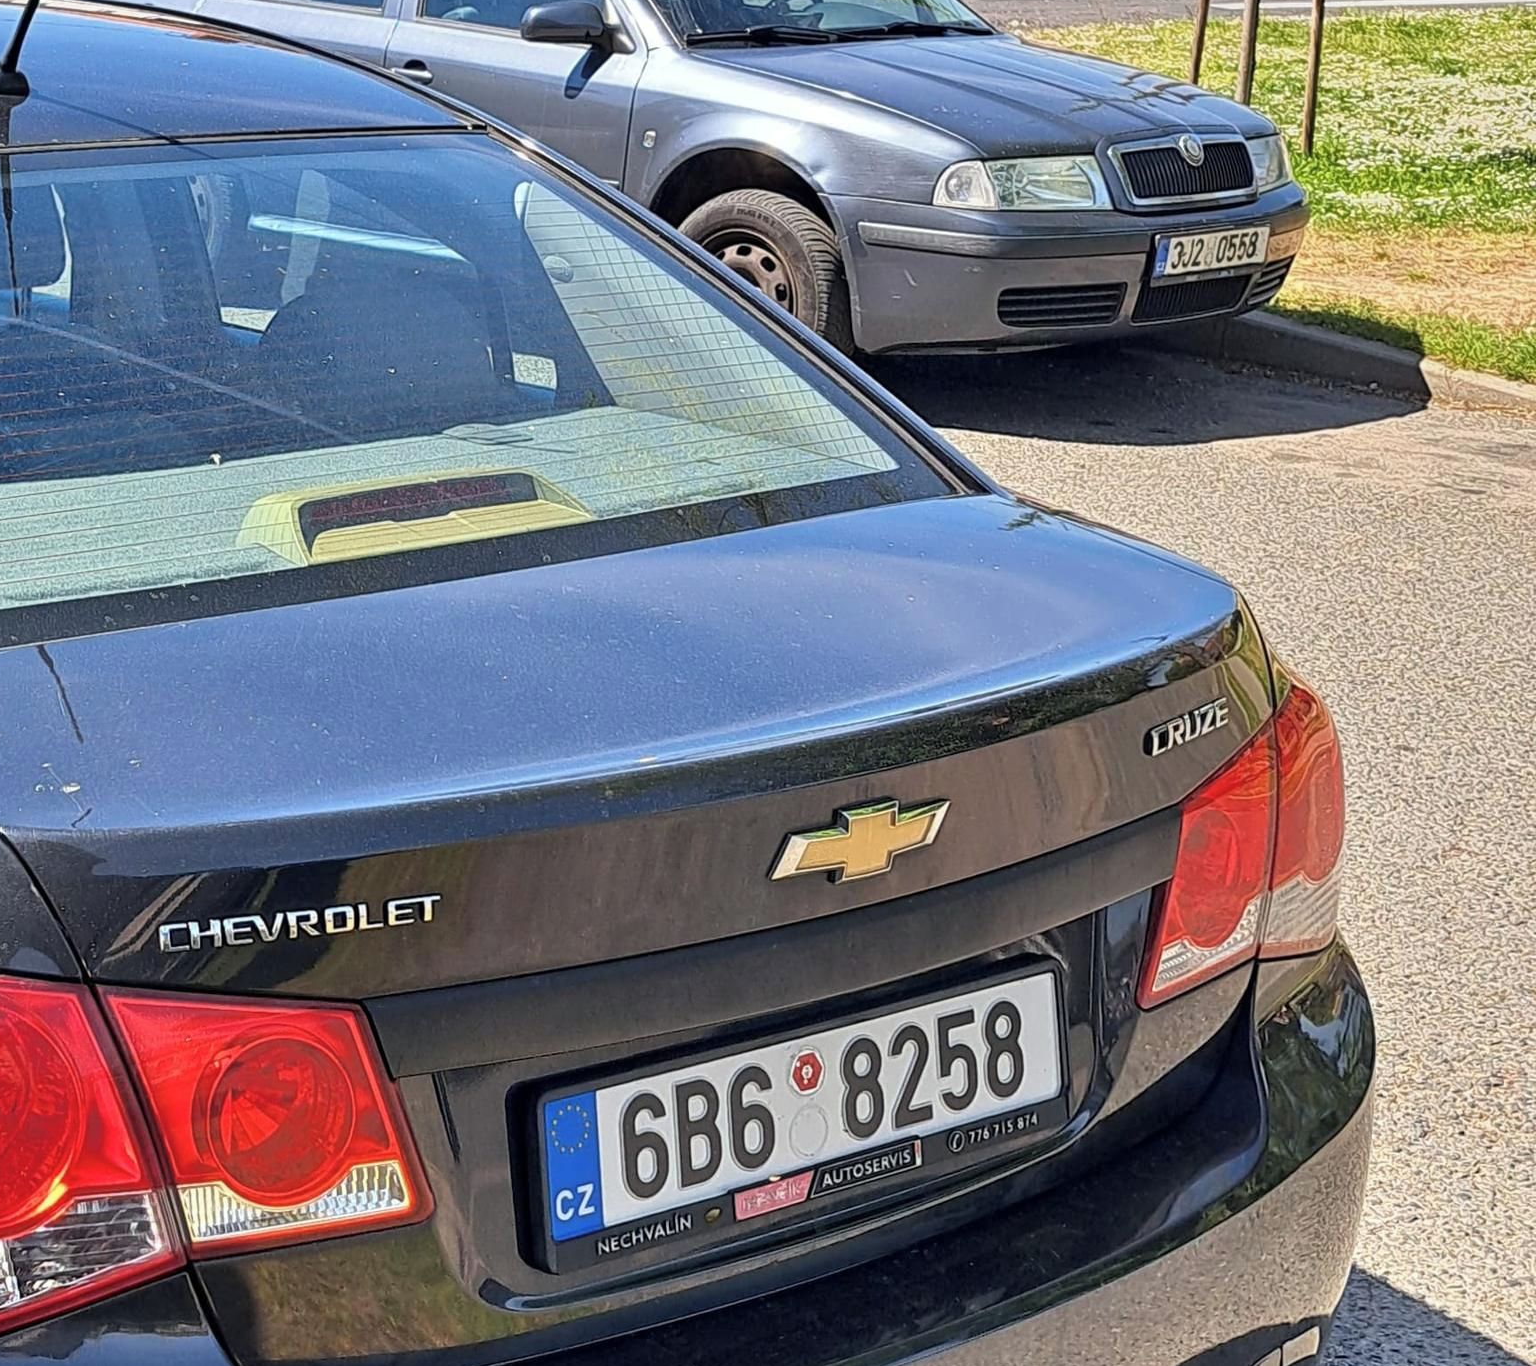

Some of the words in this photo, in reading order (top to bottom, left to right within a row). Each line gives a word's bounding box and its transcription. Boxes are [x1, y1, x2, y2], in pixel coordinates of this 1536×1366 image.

[1171, 237, 1205, 270] 3J2
[1216, 230, 1260, 264] 0558
[1150, 696, 1230, 757] CRUZE
[158, 894, 442, 954] CHEVROLET
[620, 1064, 776, 1199] 6B6
[842, 999, 1026, 1140] 8258
[967, 1126, 991, 1145] 776
[991, 1119, 1015, 1137] 715
[1016, 1111, 1039, 1131] 874
[821, 1148, 913, 1188] AUTOSERVIS
[555, 1182, 596, 1221] CZ
[596, 1212, 694, 1256] NECHVALÍN
